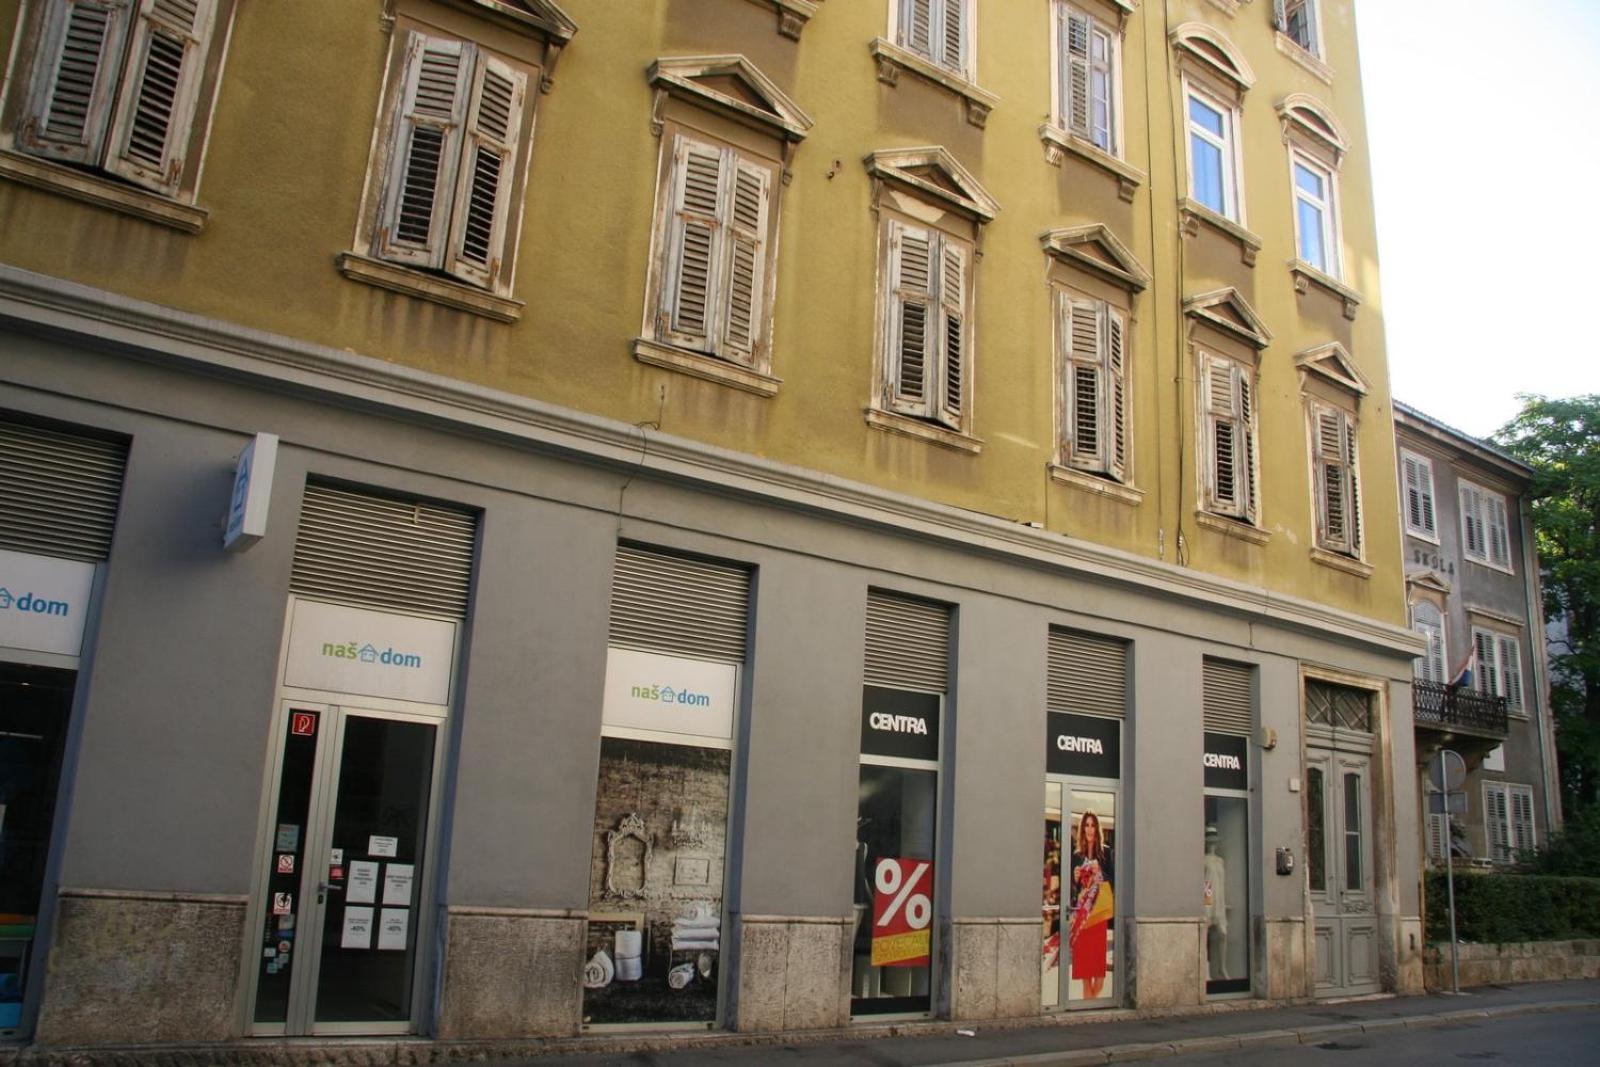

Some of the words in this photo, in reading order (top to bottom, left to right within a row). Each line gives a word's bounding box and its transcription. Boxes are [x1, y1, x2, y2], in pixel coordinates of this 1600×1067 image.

[16, 592, 69, 617] dom
[322, 641, 358, 660] naš
[380, 647, 421, 668] dom
[631, 684, 660, 701] naš
[677, 688, 710, 707] dom
[869, 711, 928, 736] CENTRA
[1057, 734, 1104, 755] CENTRA
[1203, 752, 1241, 770] CENTRA
[875, 858, 932, 929] %
